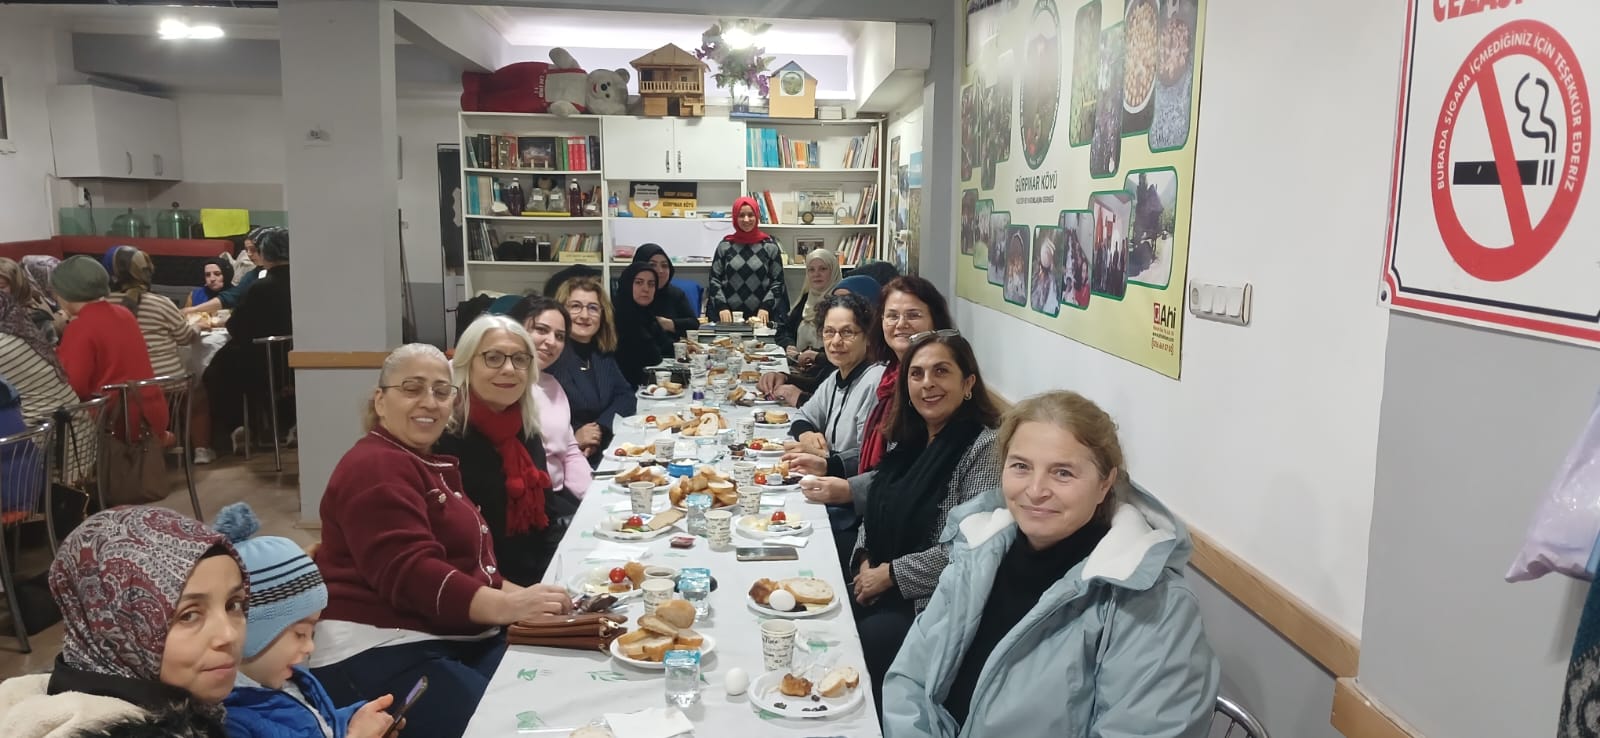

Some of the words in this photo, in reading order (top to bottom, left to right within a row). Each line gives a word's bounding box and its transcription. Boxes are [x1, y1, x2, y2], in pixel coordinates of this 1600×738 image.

[1469, 28, 1533, 75] İÇMEDİĞİNİZ
[1533, 32, 1556, 59] İÇİN
[1444, 74, 1471, 125] SİGARA
[1554, 53, 1583, 127] TEŞEKKÜR
[1041, 170, 1057, 190] KÖYÜ
[1437, 129, 1449, 190] BURADA
[1564, 131, 1582, 193] EDERİZ
[1160, 304, 1176, 329] Ahi
